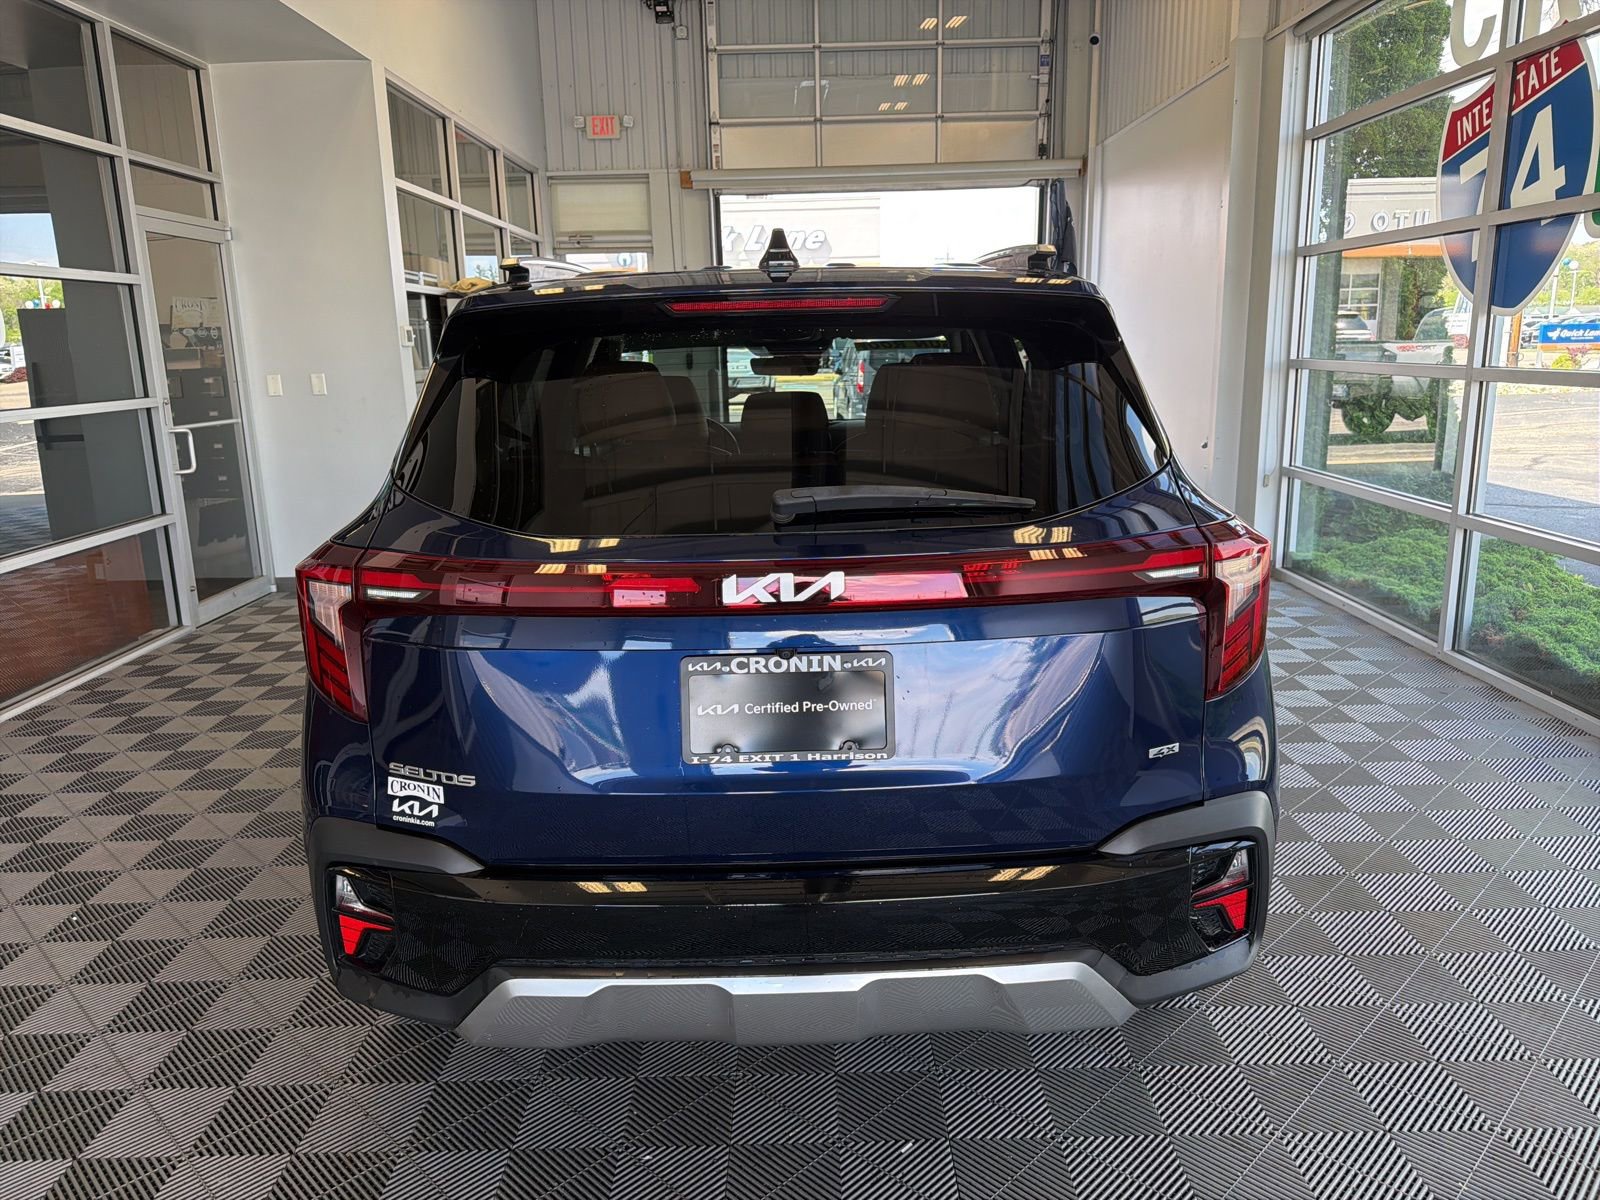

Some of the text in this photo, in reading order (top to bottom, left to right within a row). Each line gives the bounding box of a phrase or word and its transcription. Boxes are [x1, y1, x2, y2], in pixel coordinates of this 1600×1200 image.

[1457, 46, 1562, 145] INTETATE
[591, 115, 616, 137] EXIT
[744, 225, 827, 252] Lne
[722, 571, 845, 605] KIA
[688, 655, 886, 674] KIA CRONIN KIA
[697, 699, 873, 716] KIA Certified Pre-Owned
[691, 752, 888, 764] I-74 EXIT 1 Harrison
[388, 762, 477, 787] SELTOS
[390, 779, 441, 802] CRONIN
[392, 798, 439, 818] KIA
[392, 814, 436, 828] croninkia.com
